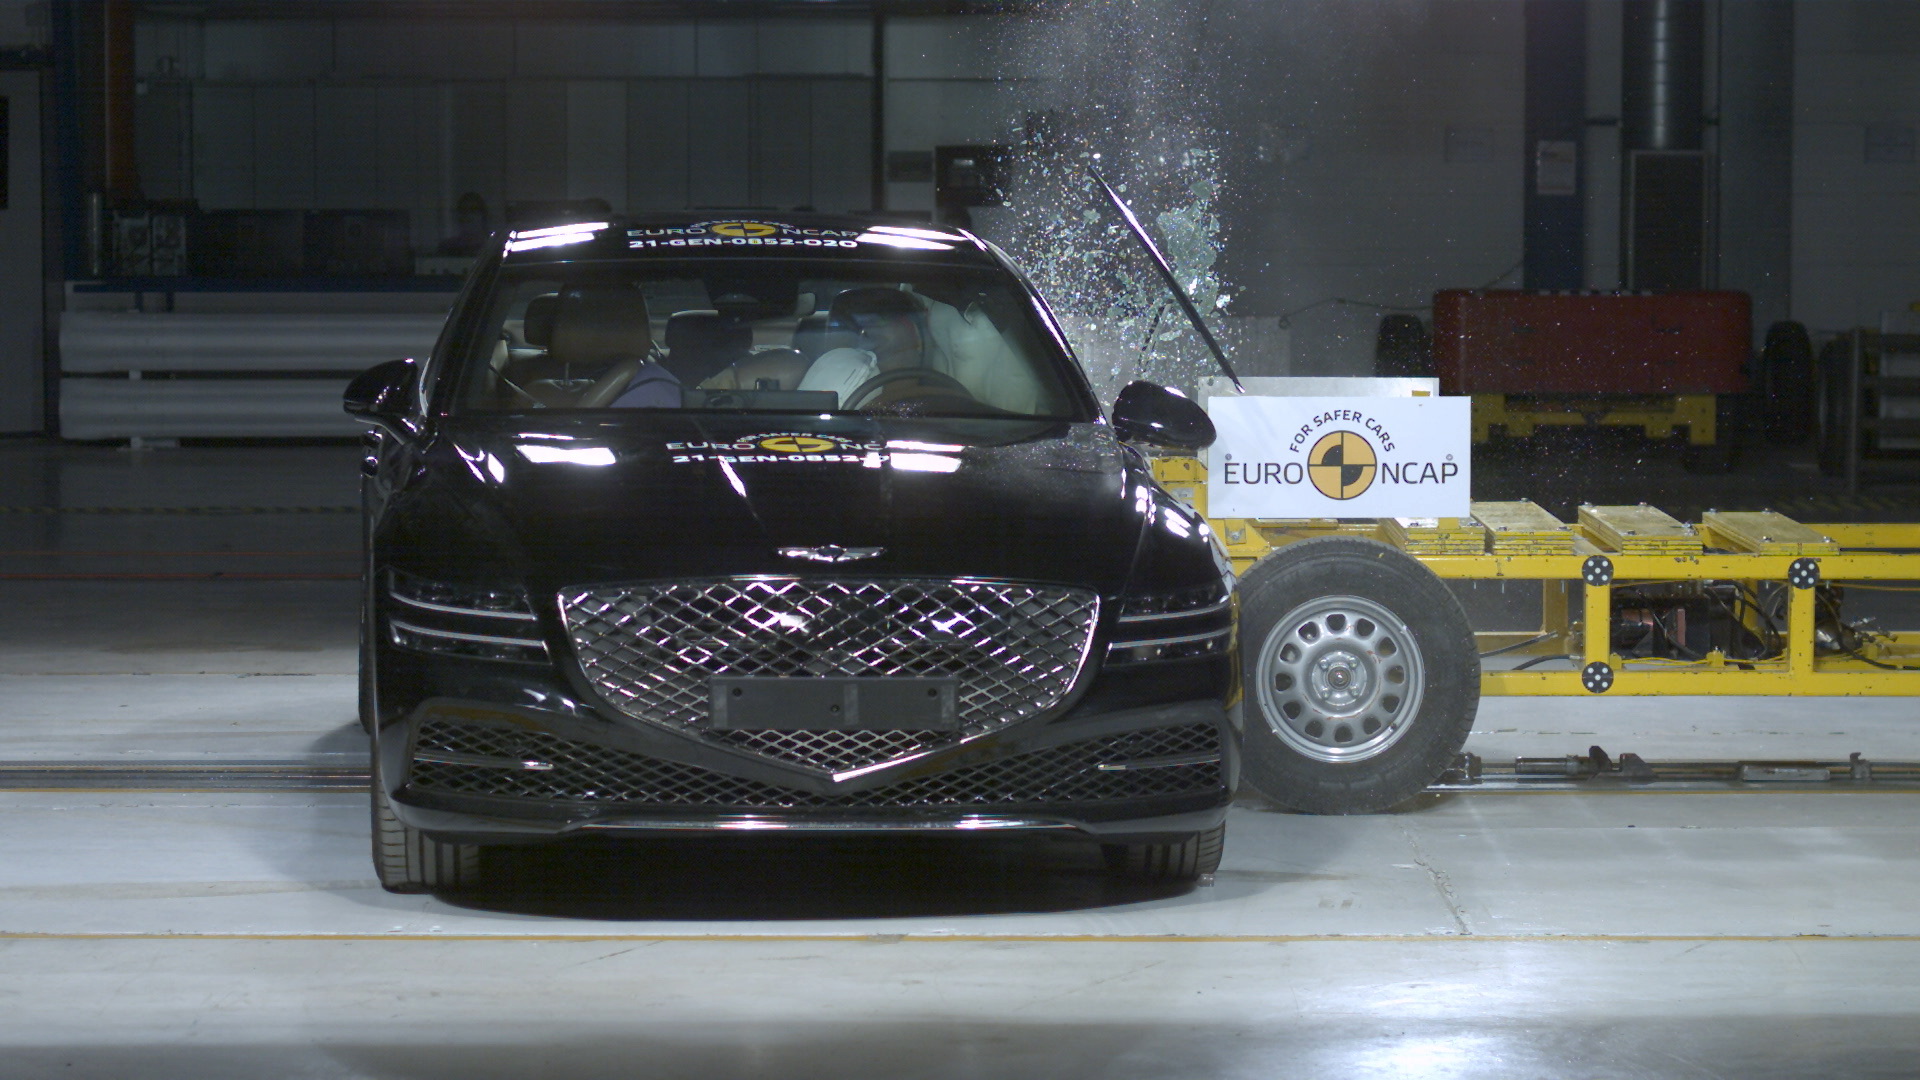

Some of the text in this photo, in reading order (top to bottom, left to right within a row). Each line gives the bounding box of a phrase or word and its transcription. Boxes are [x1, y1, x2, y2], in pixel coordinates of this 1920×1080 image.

[626, 228, 859, 238] EURO NCAP
[628, 237, 858, 249] 21-GEN-0852-020
[1289, 409, 1396, 453] FOR SAFER CARS
[665, 441, 756, 450] EURO
[1223, 462, 1459, 485] EURO NCAP
